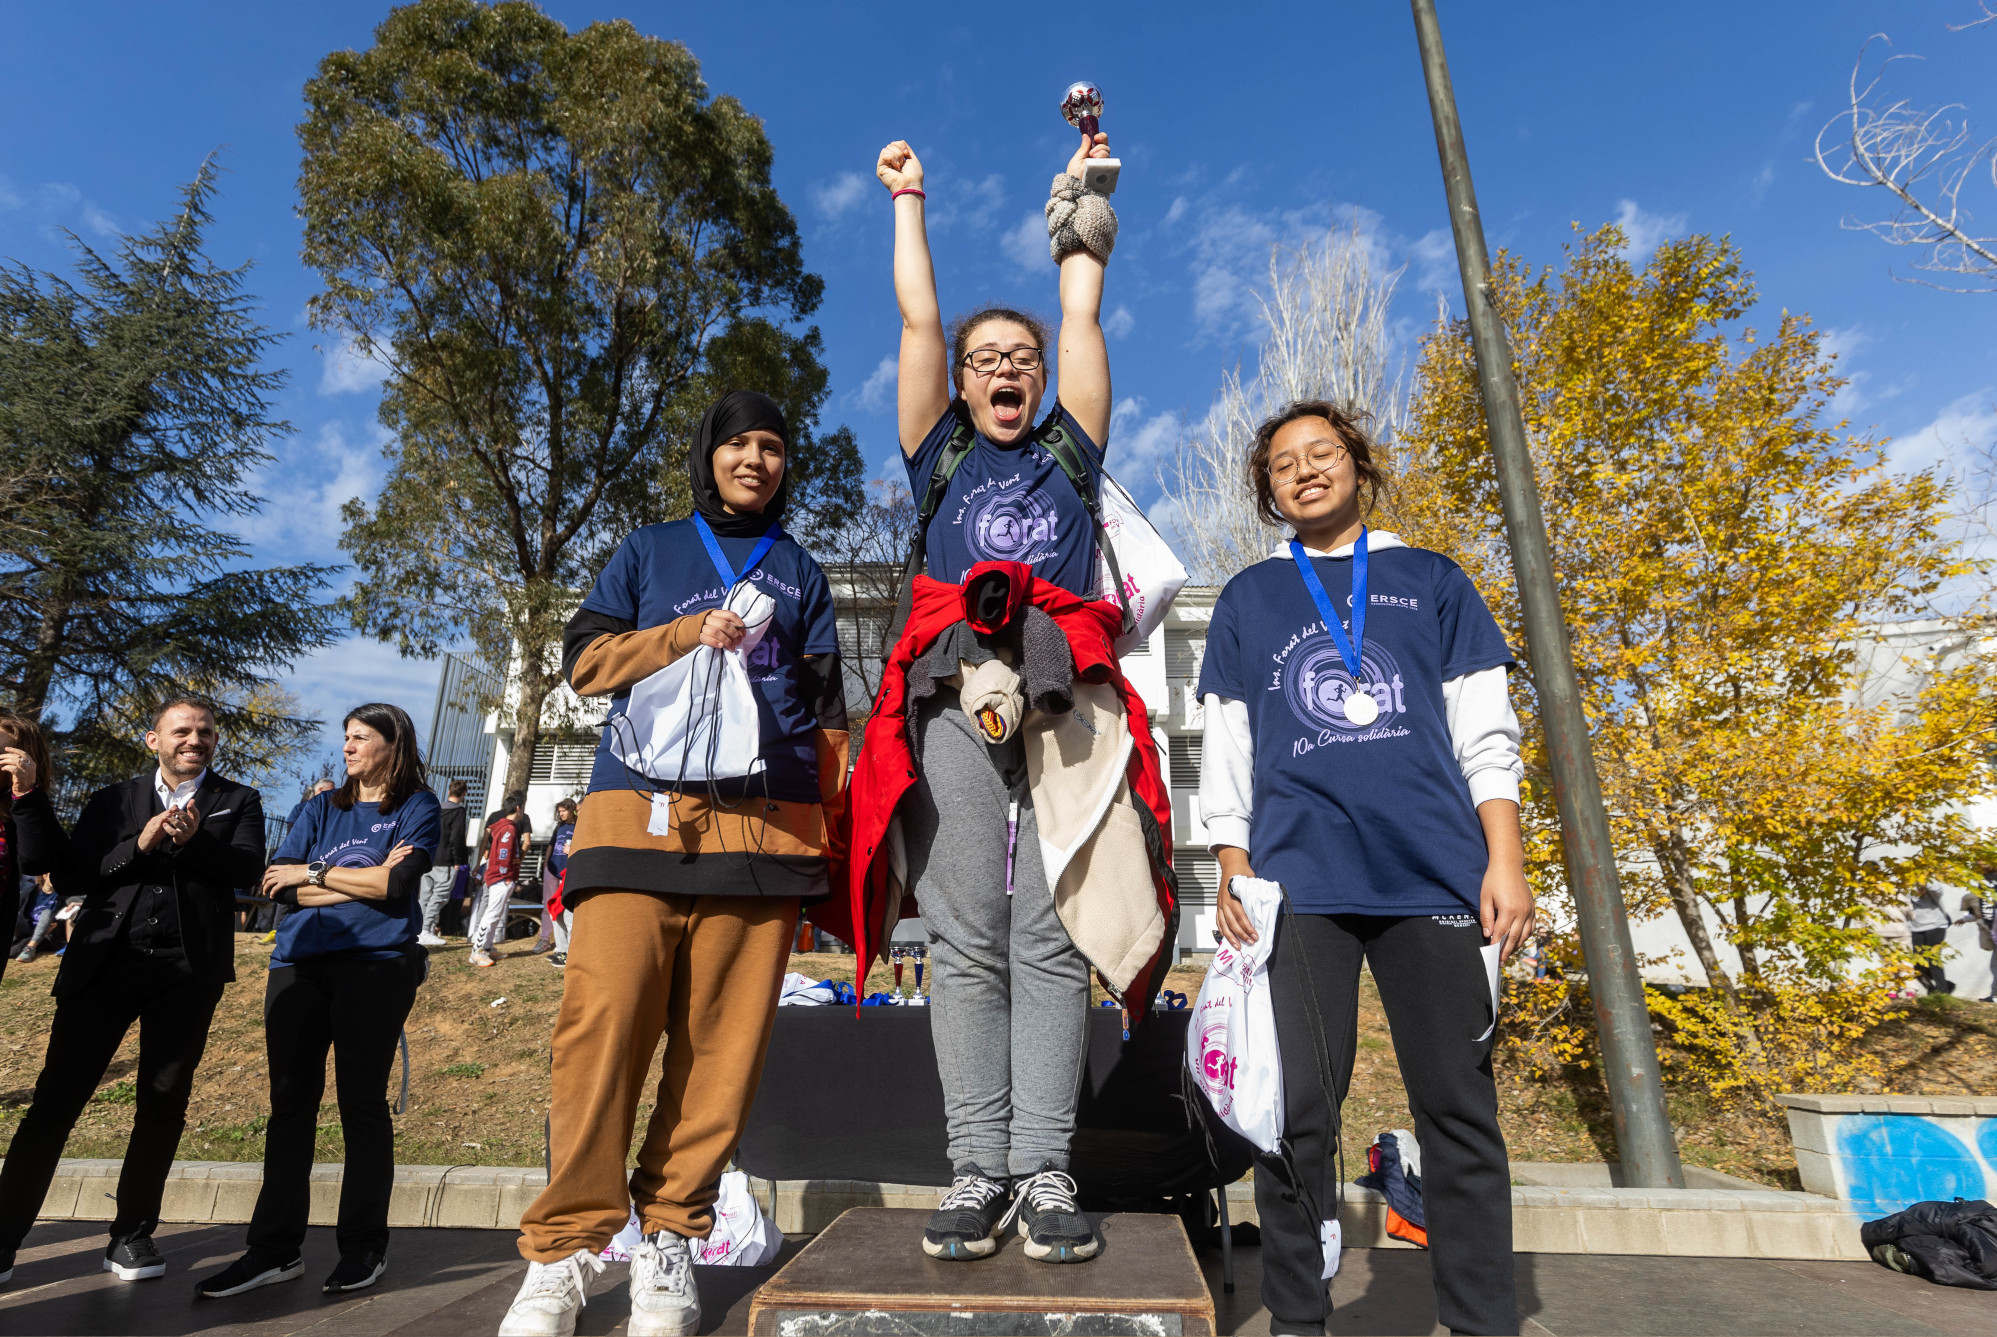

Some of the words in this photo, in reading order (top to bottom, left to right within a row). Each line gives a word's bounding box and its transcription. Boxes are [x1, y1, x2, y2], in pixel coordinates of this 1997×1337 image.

[767, 574, 801, 597] ERSCE
[673, 593, 701, 615] Forat
[704, 588, 718, 600] del
[1370, 595, 1418, 607] ERSCE
[1273, 634, 1301, 664] Forat
[1302, 623, 1318, 639] del
[1292, 738, 1316, 758] 10a
[1317, 729, 1356, 747] Cursa
[1357, 725, 1411, 743] solidària
[339, 839, 350, 850] del
